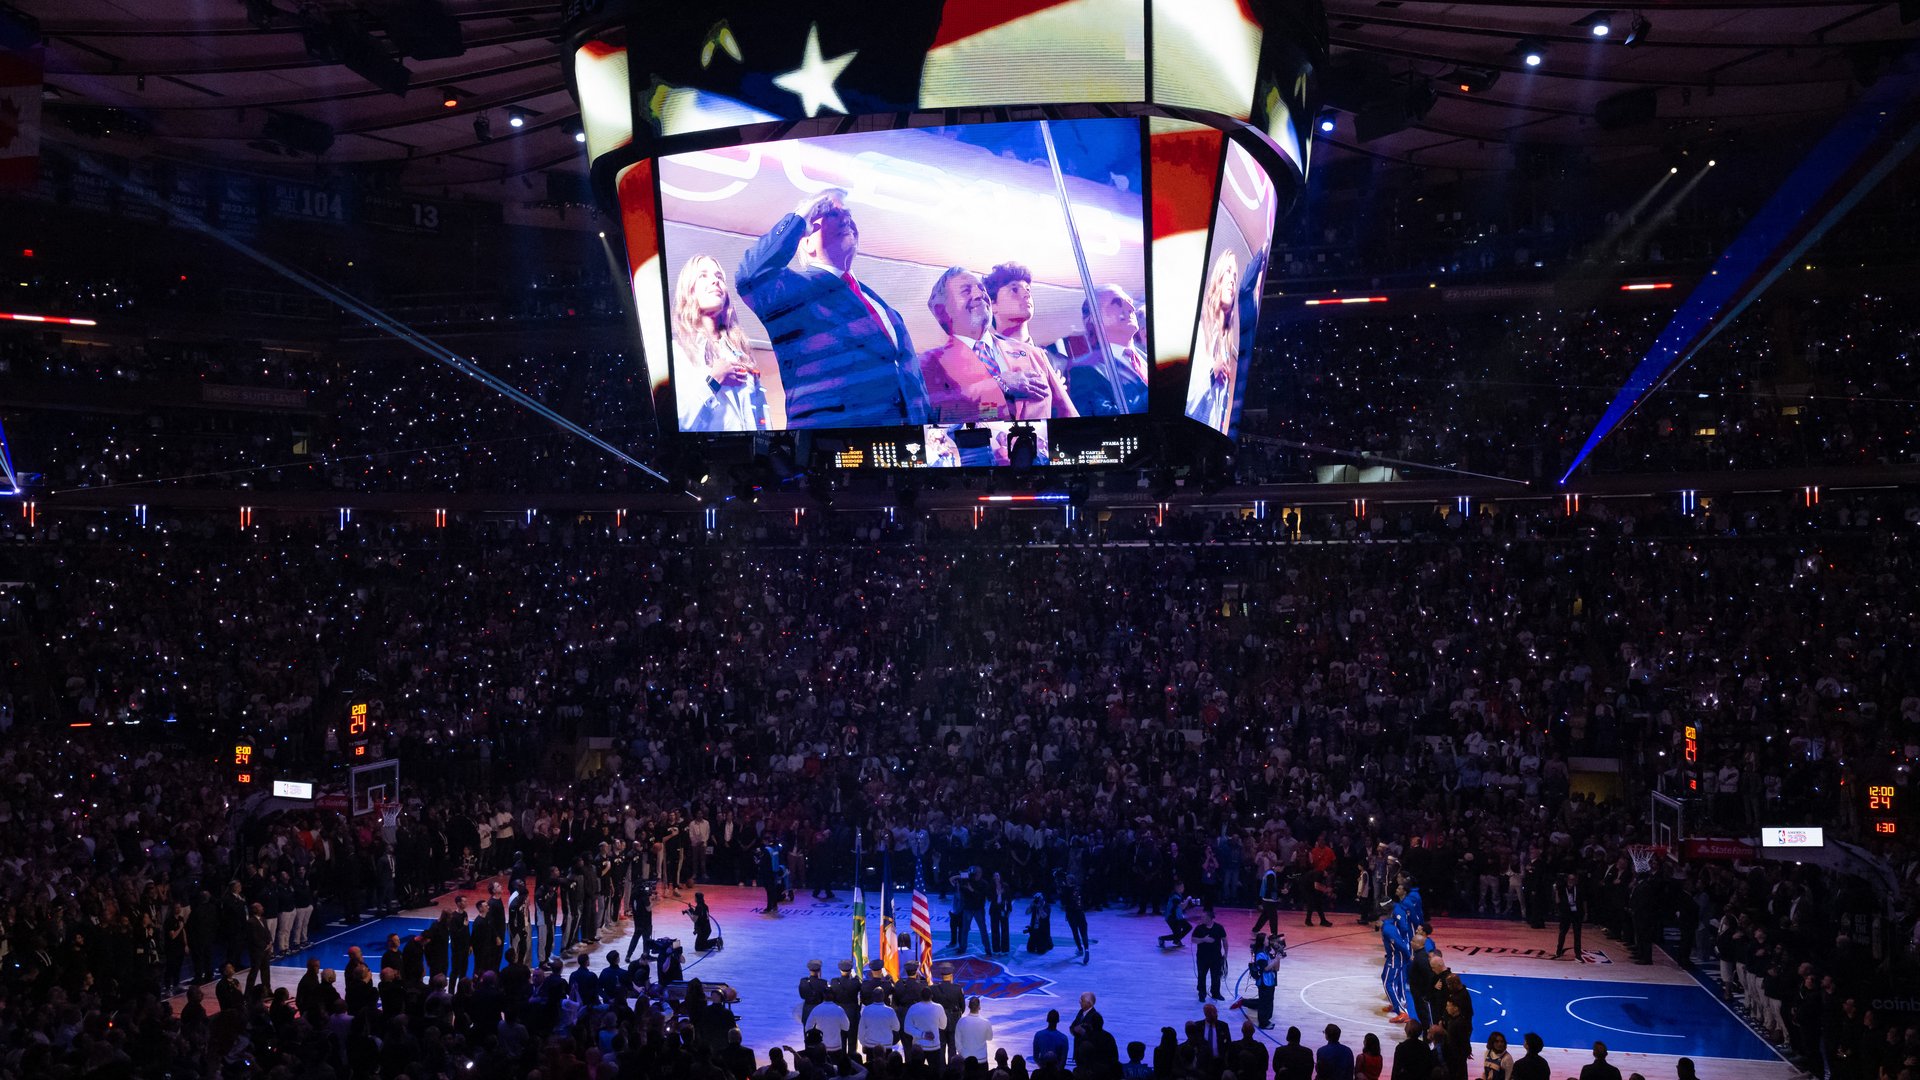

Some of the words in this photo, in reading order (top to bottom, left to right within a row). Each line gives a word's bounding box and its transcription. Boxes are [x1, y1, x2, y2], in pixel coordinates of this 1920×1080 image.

[302, 190, 344, 220] 104
[366, 195, 402, 208] PHISH
[412, 203, 440, 228] 13
[350, 715, 366, 734] 24
[1686, 738, 1696, 762] 24
[236, 754, 248, 764] 24
[1870, 786, 1894, 796] 12:00
[1870, 797, 1890, 809] 24
[1876, 823, 1895, 832] 1:30
[1711, 846, 1732, 854] State
